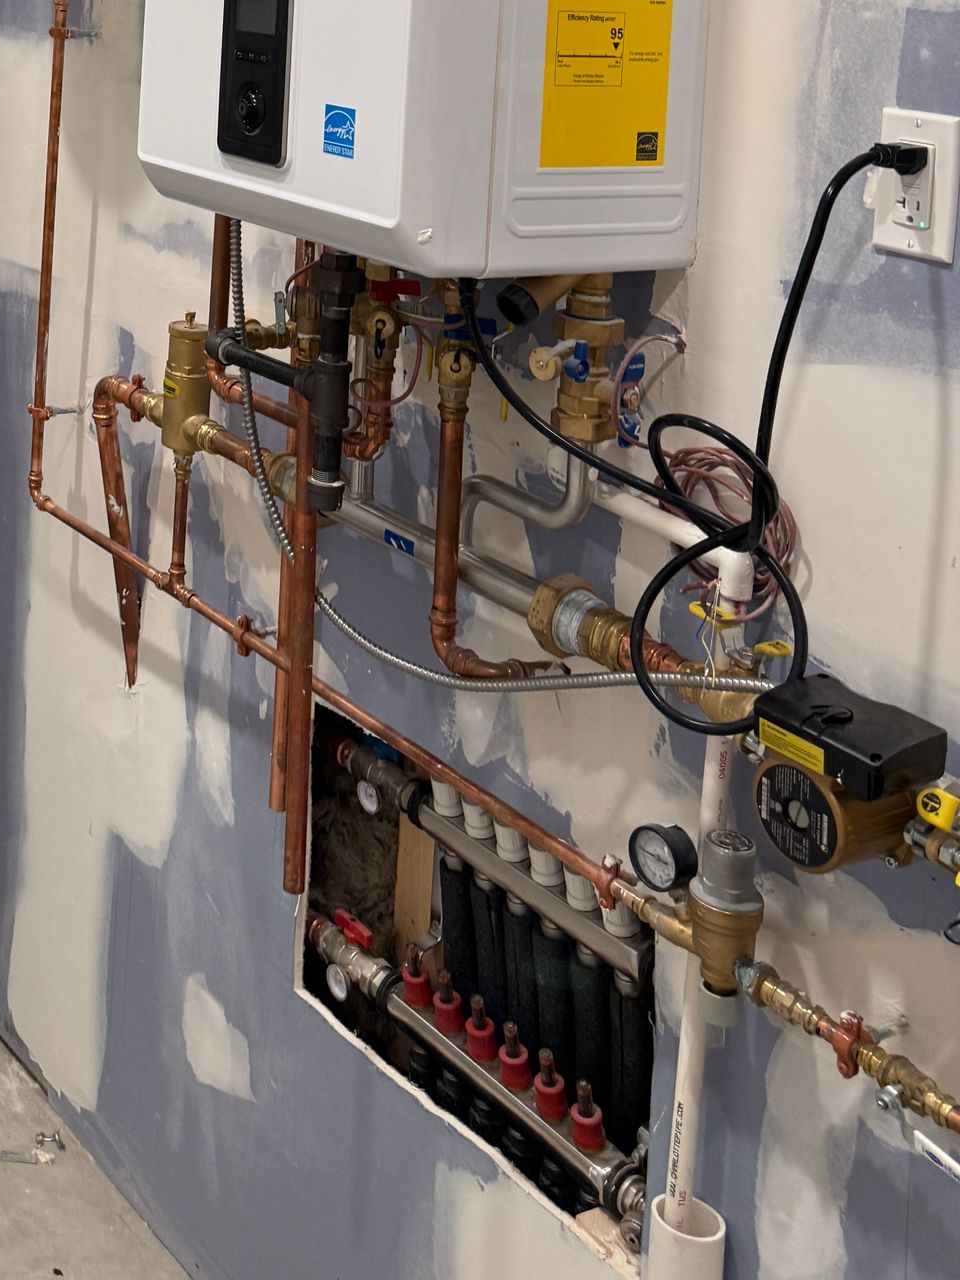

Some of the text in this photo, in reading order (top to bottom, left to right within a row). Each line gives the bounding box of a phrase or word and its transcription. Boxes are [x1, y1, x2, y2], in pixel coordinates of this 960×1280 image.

[567, 13, 590, 23] Efficiency
[610, 27, 624, 40] 95
[323, 143, 341, 155] ENERGY
